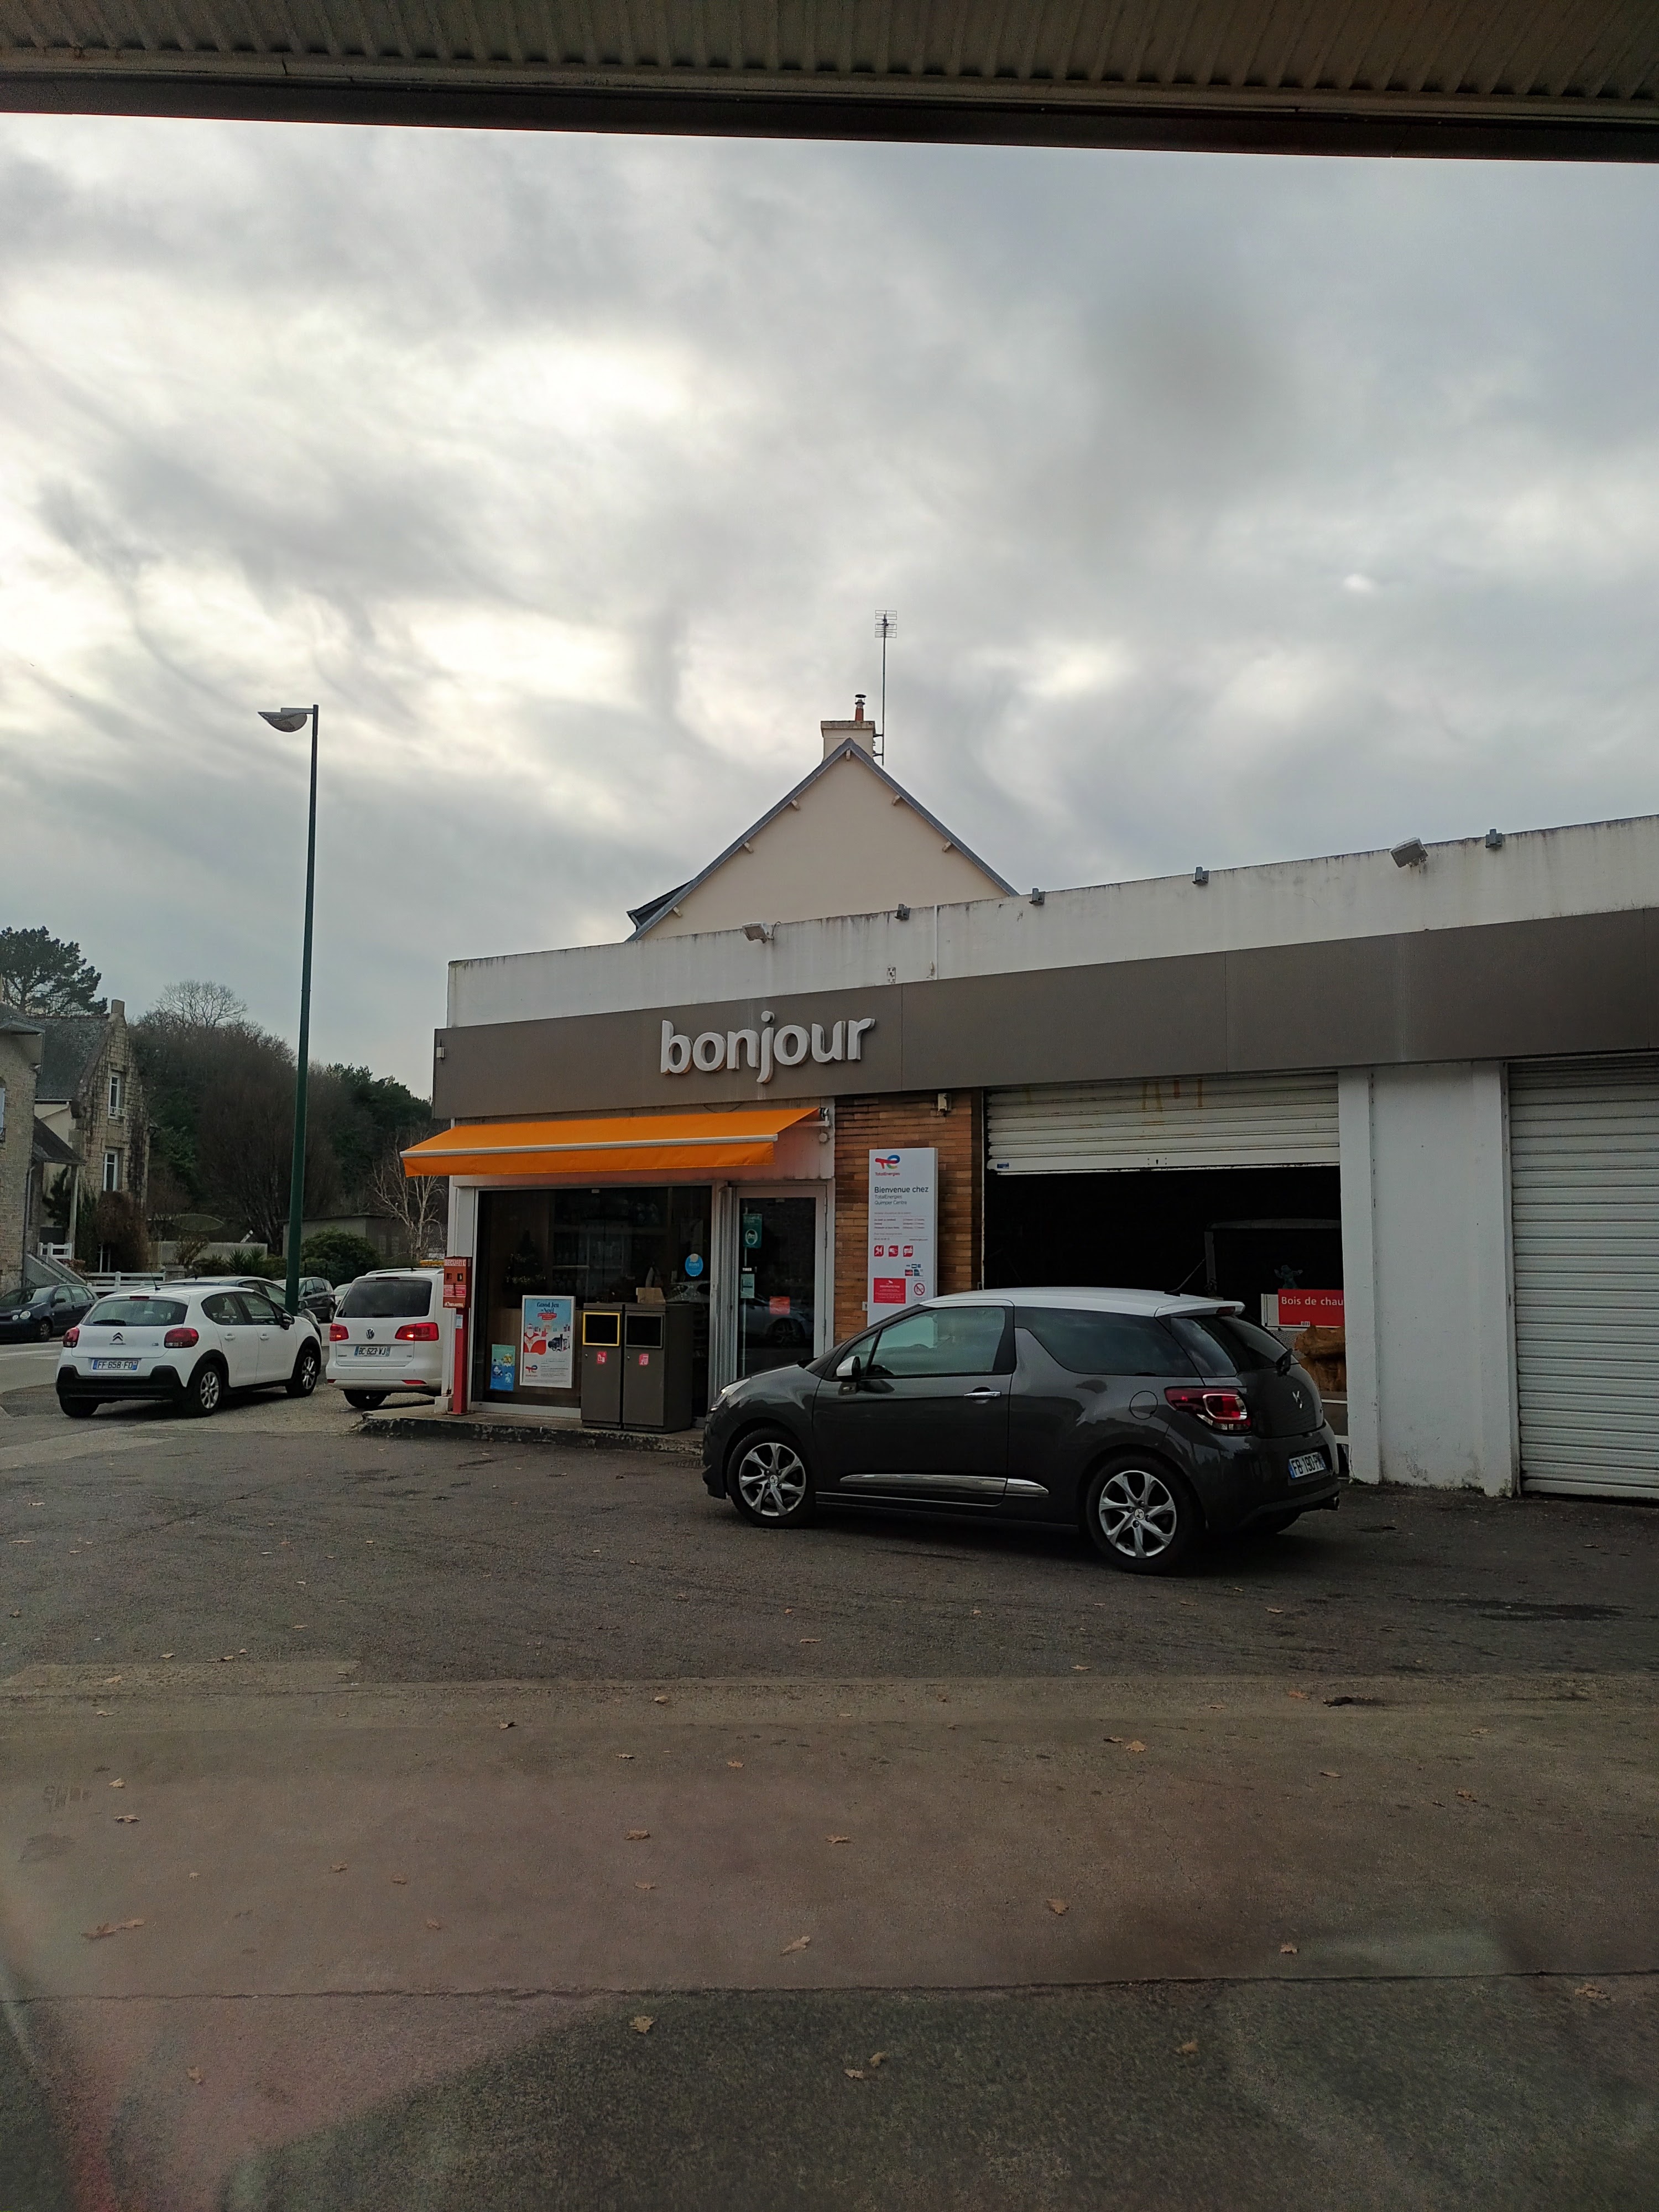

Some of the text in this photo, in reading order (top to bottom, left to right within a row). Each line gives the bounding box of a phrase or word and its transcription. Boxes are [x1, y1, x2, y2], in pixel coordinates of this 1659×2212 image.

[661, 1011, 875, 1083] bonjour
[1281, 1296, 1301, 1305] Bois
[1305, 1297, 1316, 1305] de
